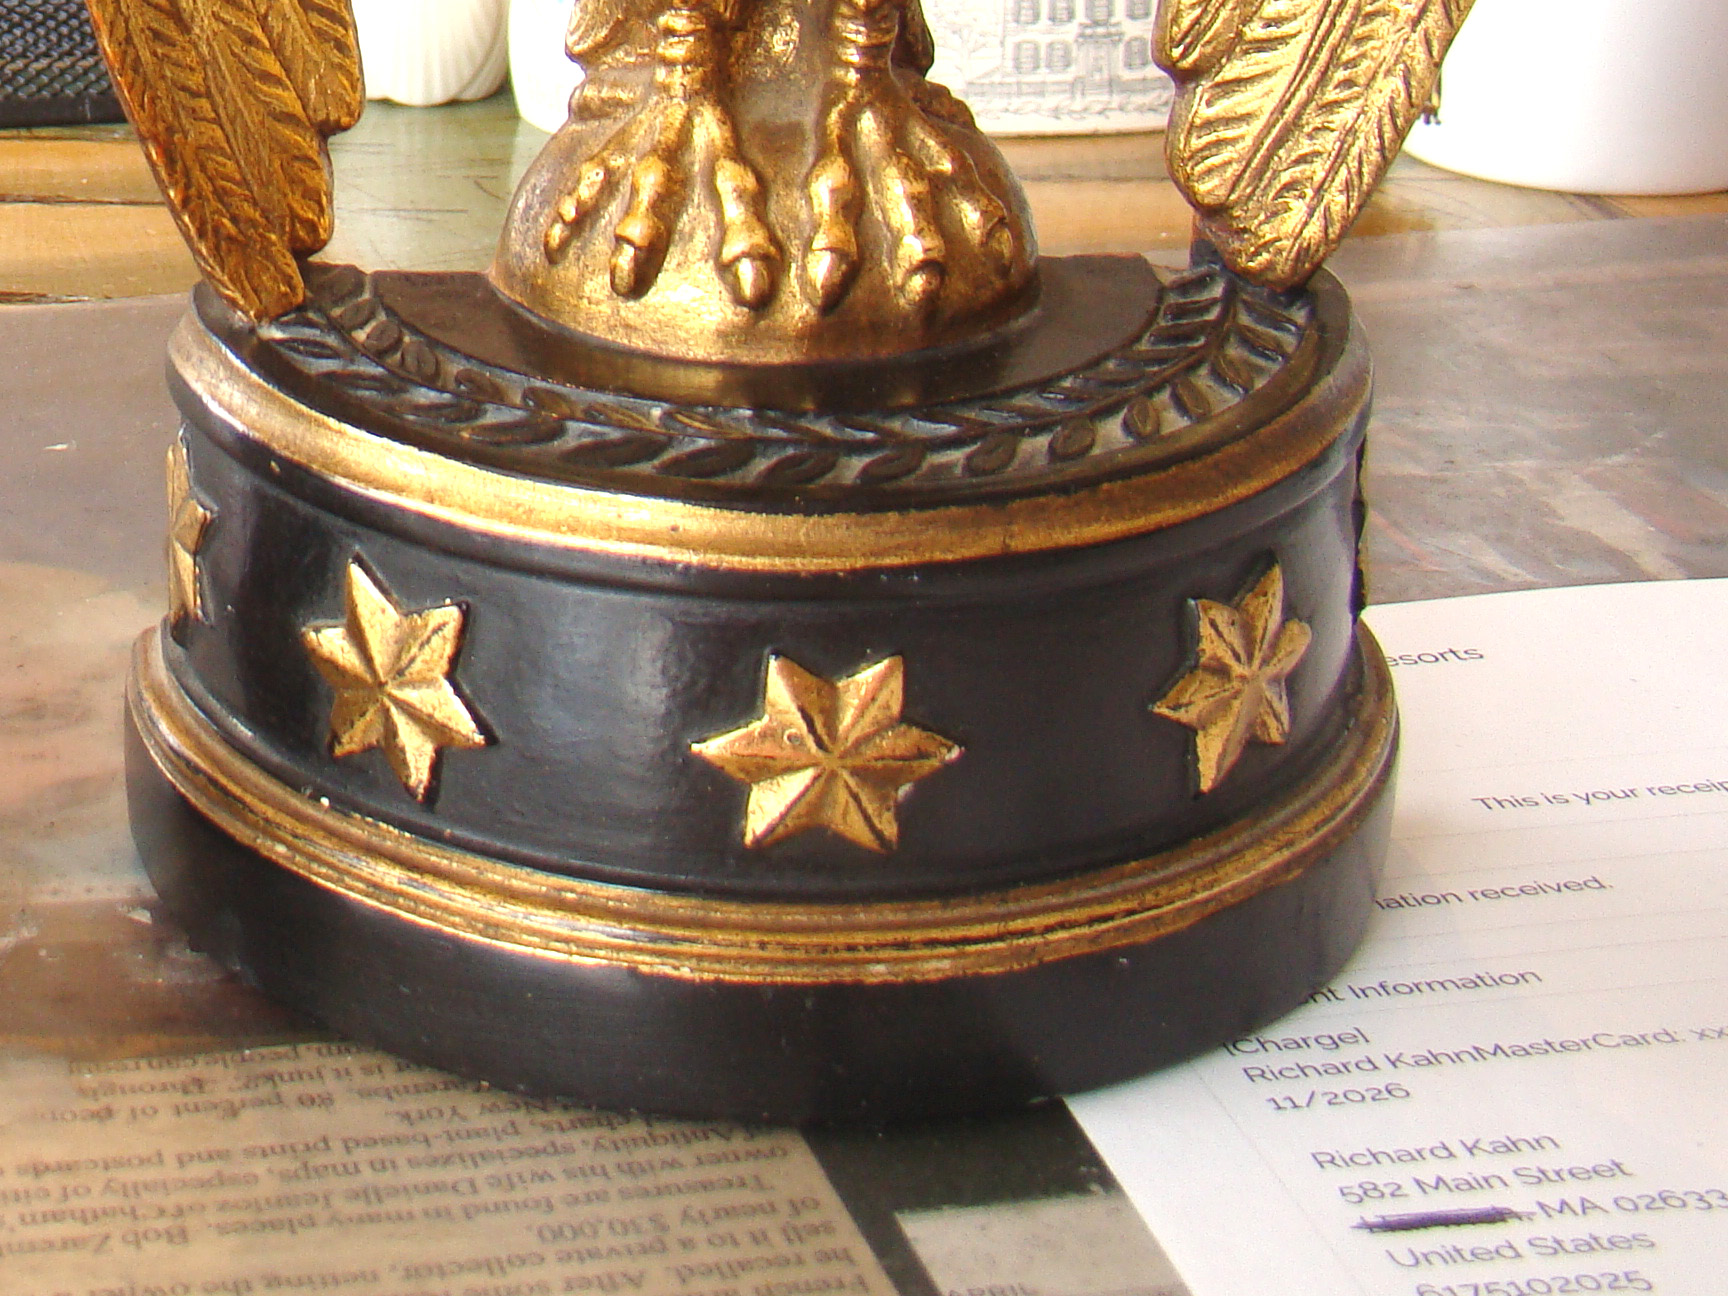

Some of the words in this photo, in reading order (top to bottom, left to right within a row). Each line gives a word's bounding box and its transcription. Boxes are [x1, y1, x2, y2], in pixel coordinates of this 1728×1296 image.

[1472, 793, 1539, 810] This
[1540, 792, 1570, 806] is
[1572, 786, 1639, 806] your
[1467, 875, 1613, 901] received.
[1347, 970, 1542, 999] Information
[1243, 1056, 1381, 1083] Richard
[1265, 1082, 1411, 1111] 11/2026
[1311, 1141, 1457, 1169] Richard
[1459, 1135, 1561, 1157] Kahn
[1338, 1181, 1409, 1204] 582
[1412, 1172, 1510, 1195] Main
[1512, 1159, 1634, 1185] Street
[1535, 1196, 1610, 1218] MA
[1385, 1240, 1523, 1268] United
[1527, 1232, 1656, 1256] States
